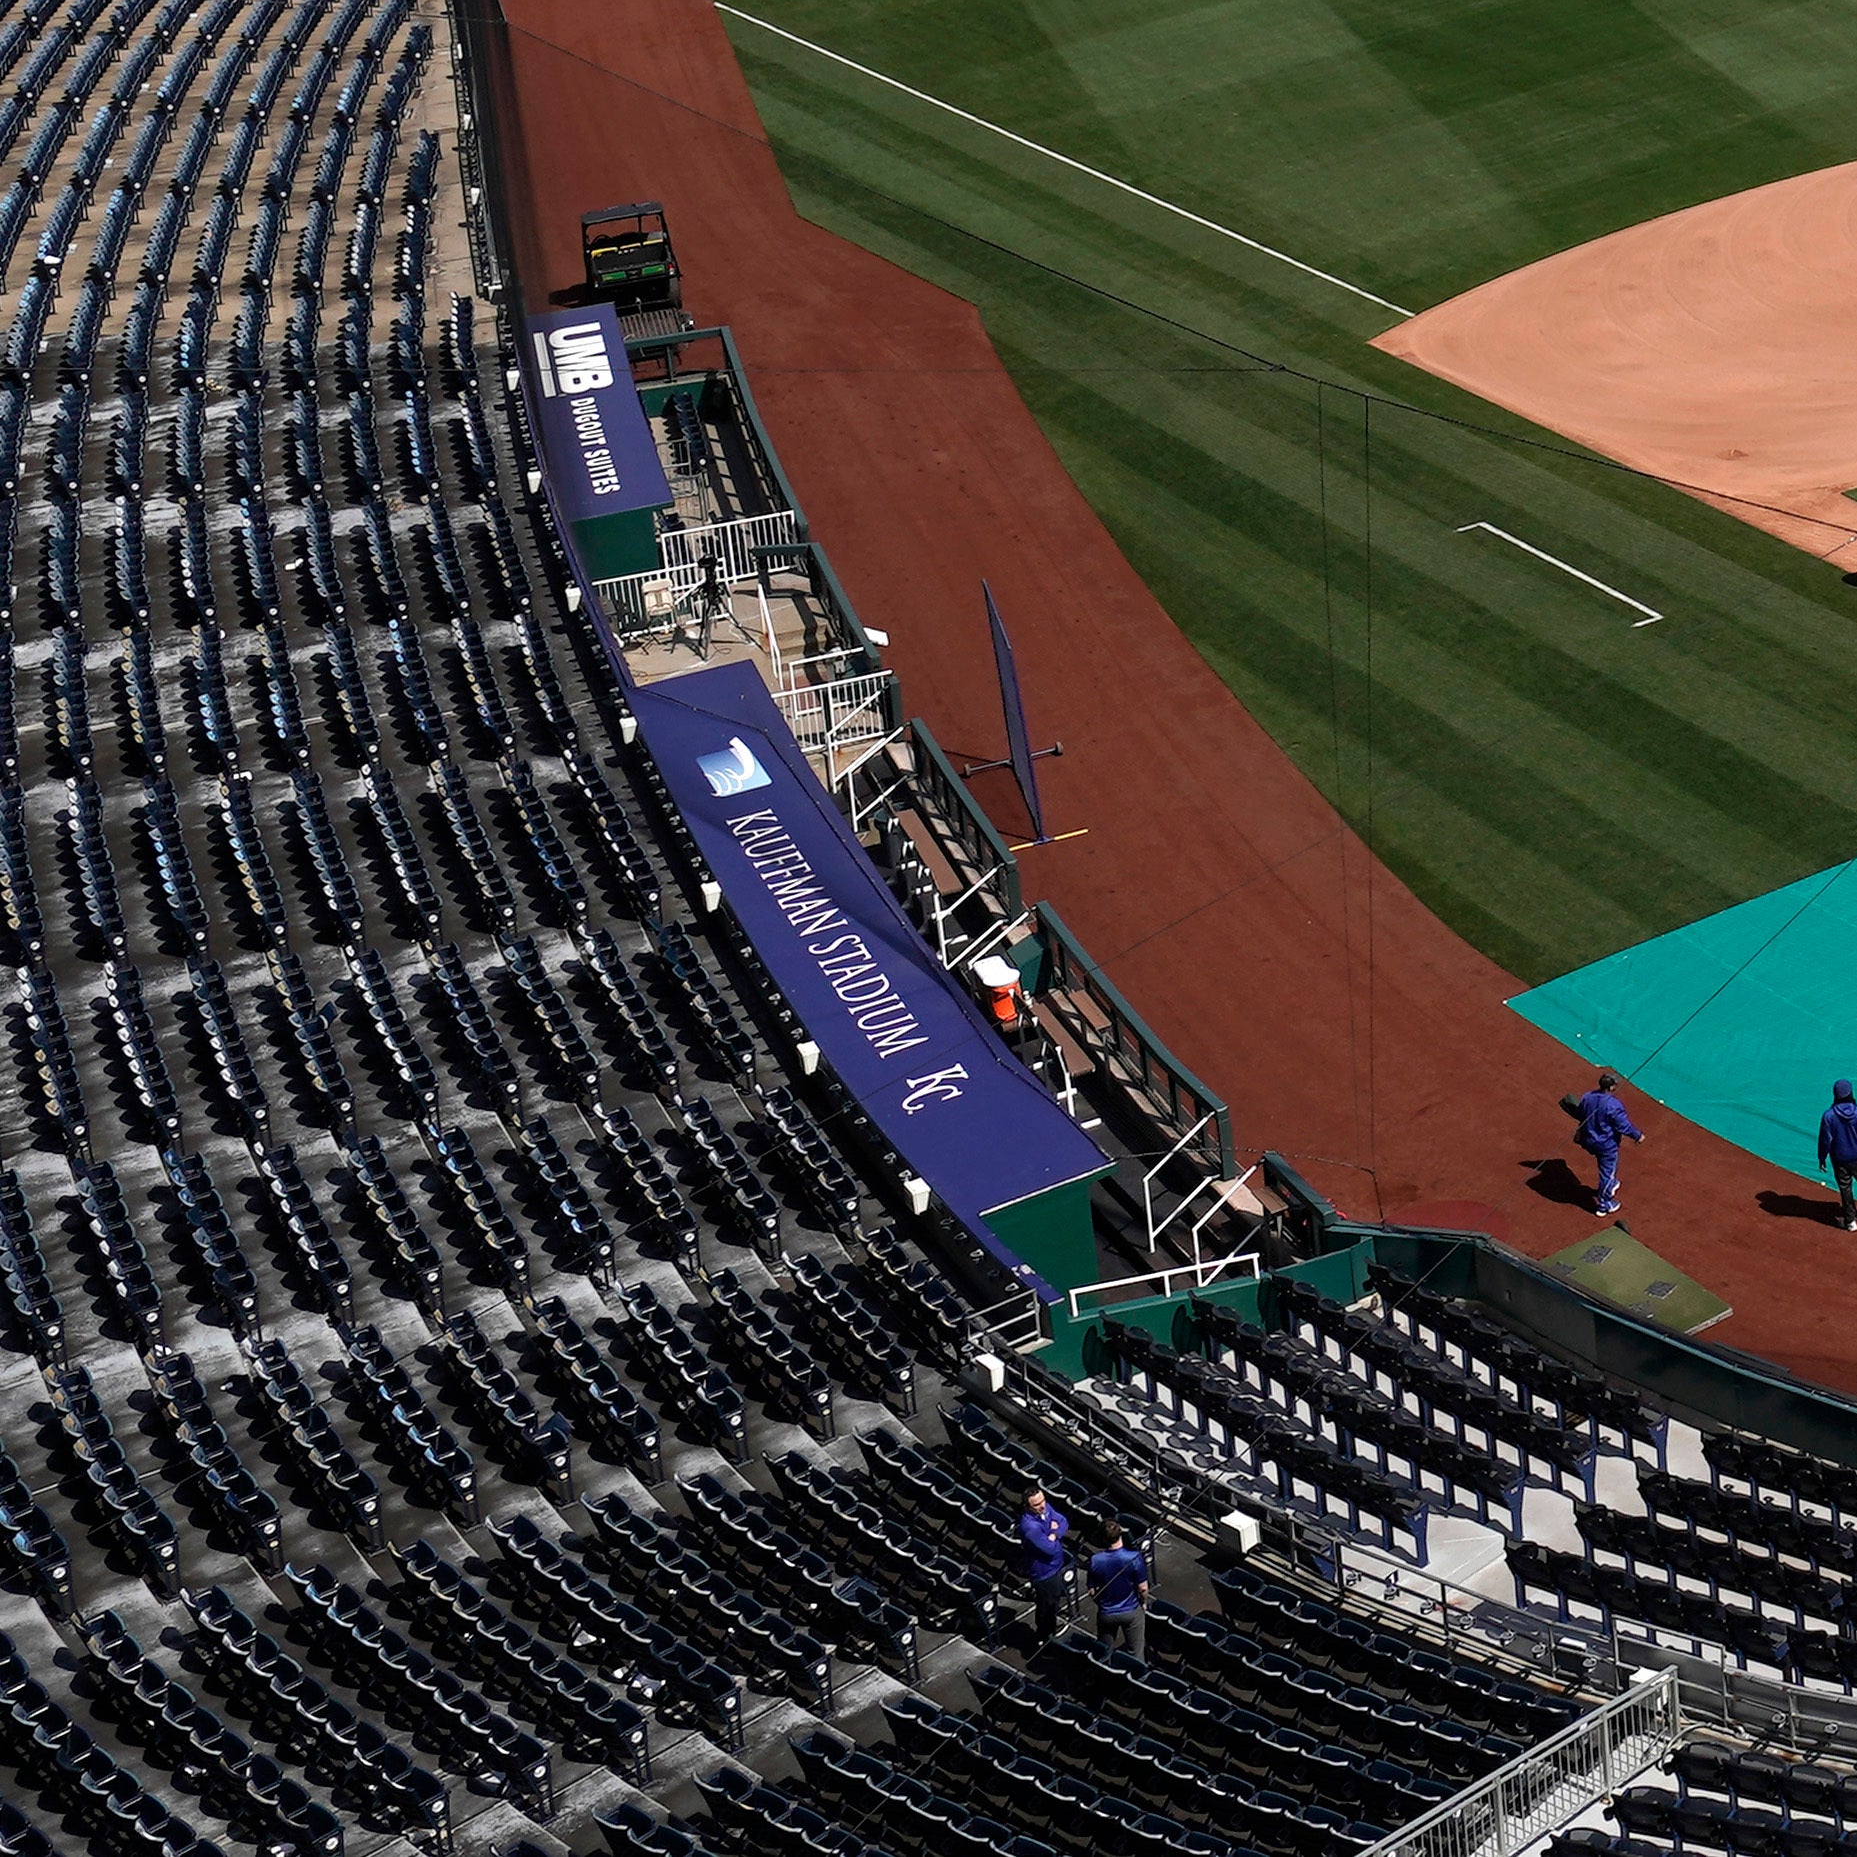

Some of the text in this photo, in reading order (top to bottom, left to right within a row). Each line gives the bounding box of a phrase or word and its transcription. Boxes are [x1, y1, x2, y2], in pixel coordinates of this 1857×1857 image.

[549, 321, 621, 495] UMB DUGOUT SUITES
[725, 807, 970, 1115] KAUFFMAN STADIUM KC
